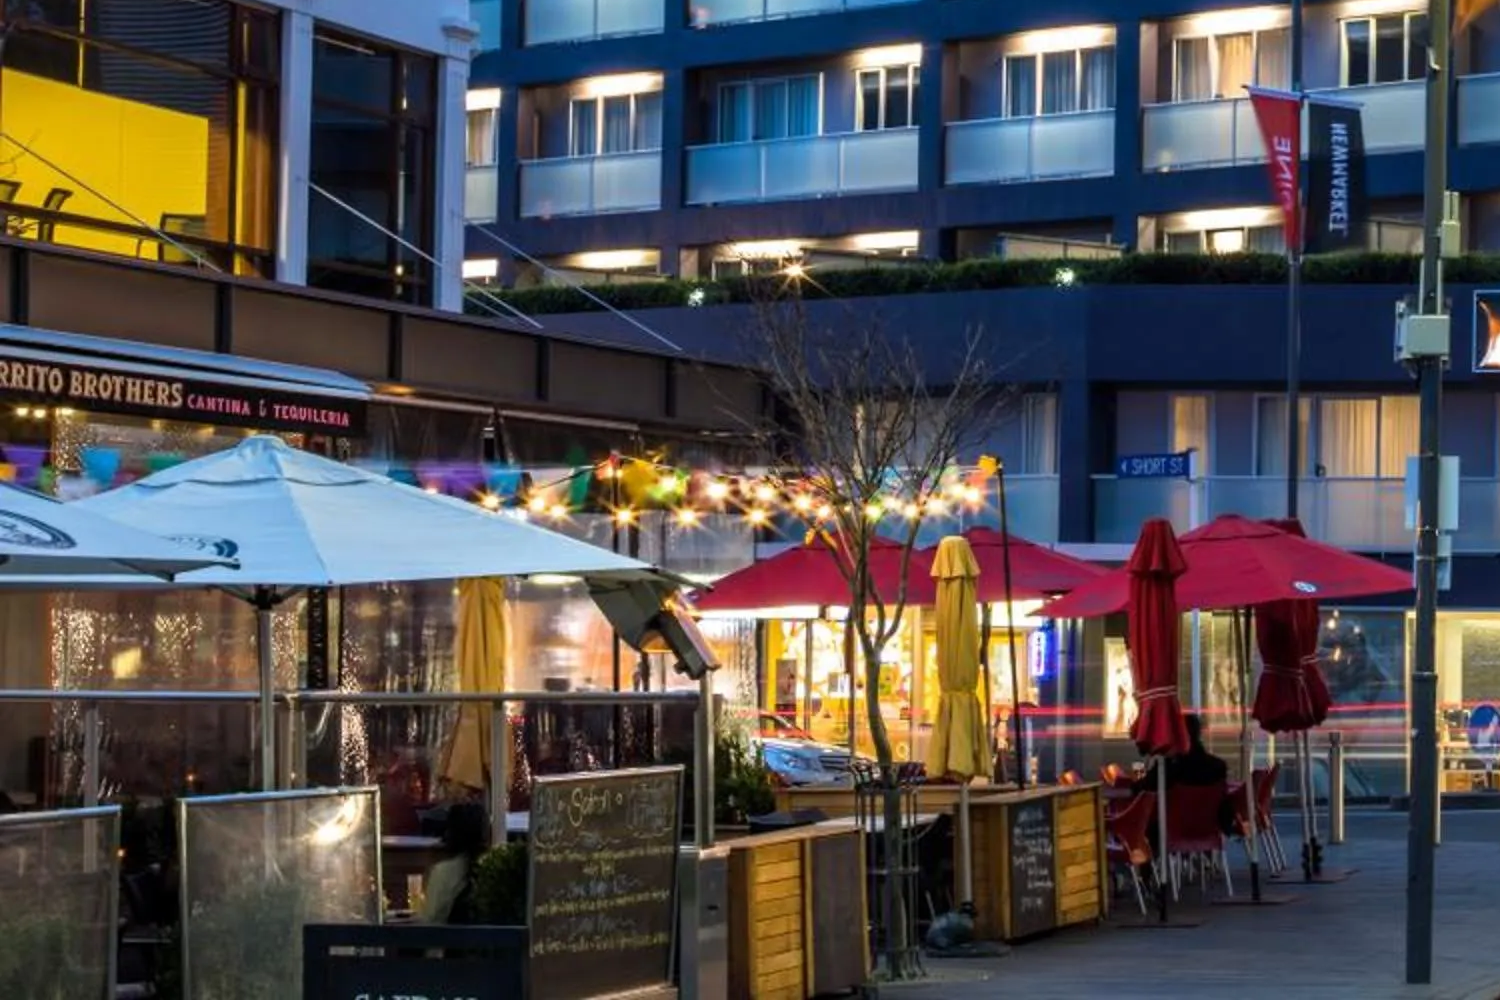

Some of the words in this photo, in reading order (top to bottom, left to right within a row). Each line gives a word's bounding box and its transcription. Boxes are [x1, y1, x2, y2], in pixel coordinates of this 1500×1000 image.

[69, 370, 183, 409] BROTHERS
[187, 394, 251, 416] CANTINA
[273, 403, 350, 427] TEQUILERIA
[1131, 457, 1166, 475] SHORT
